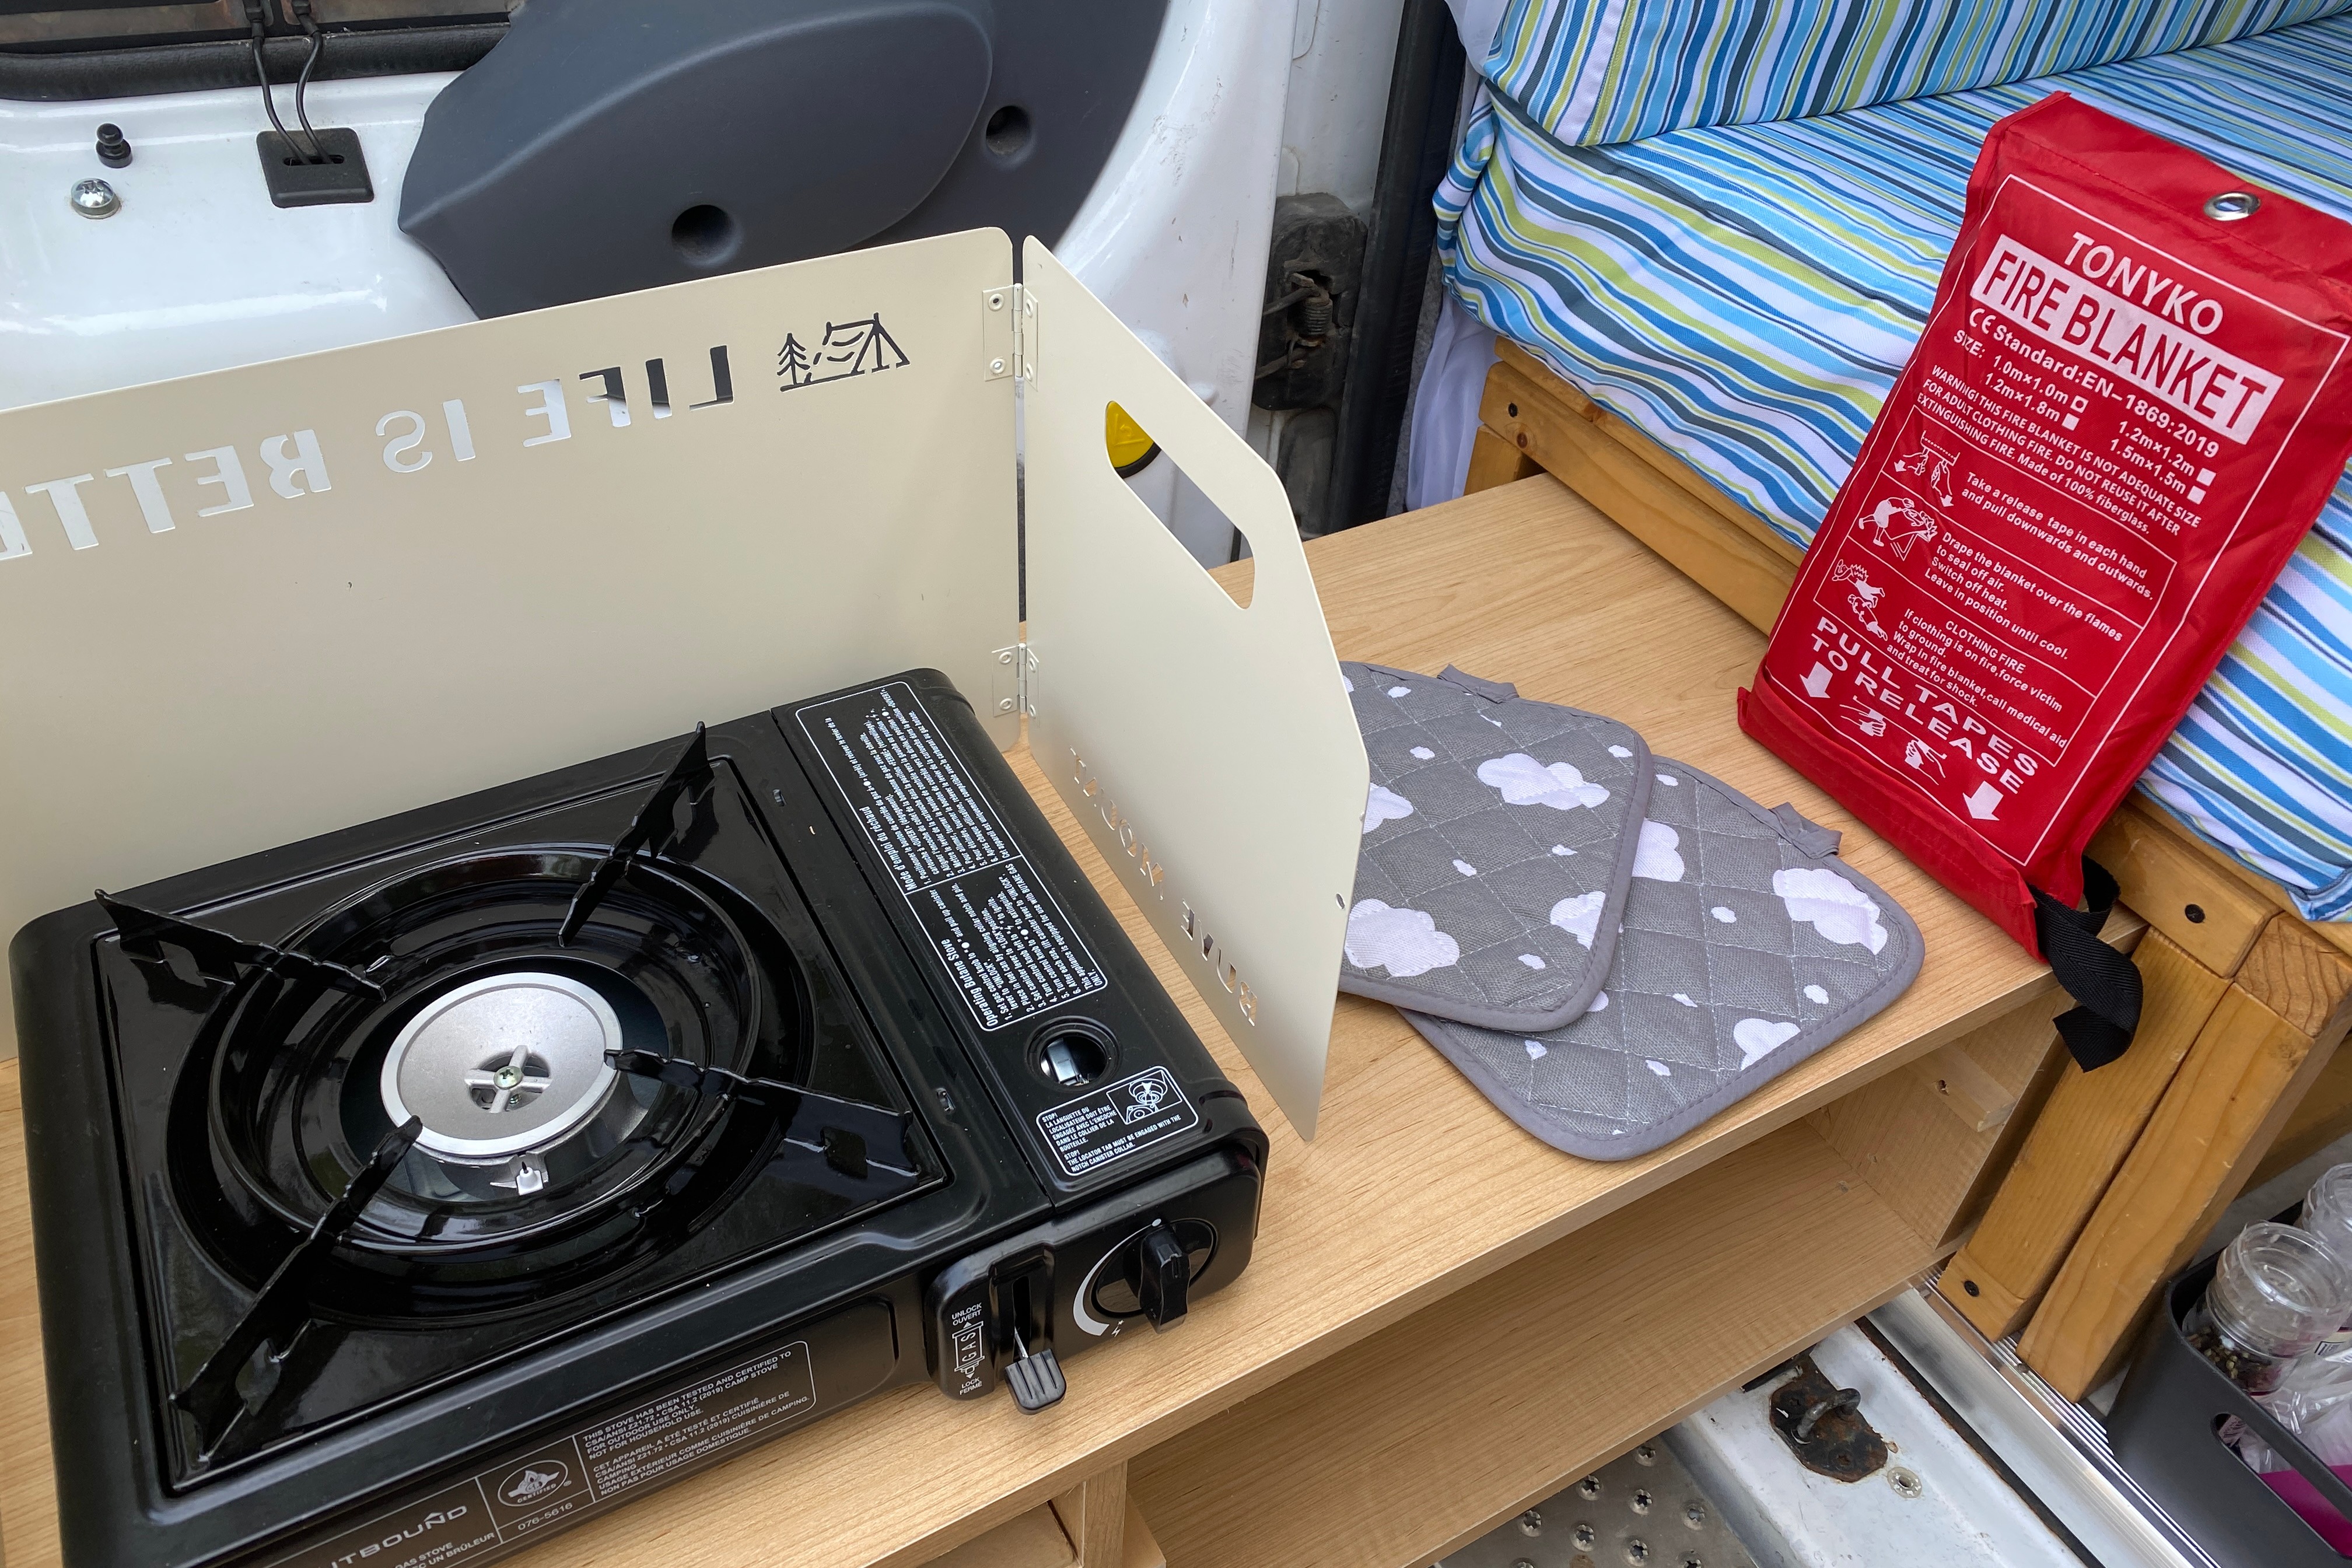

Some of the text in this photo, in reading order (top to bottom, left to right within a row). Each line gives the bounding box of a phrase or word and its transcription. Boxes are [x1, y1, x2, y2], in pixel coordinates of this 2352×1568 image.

[2064, 232, 2223, 334] TONYKO
[1983, 250, 2267, 429] FIRE BLANKET
[1917, 393, 2149, 534] EXTINGUISHING FIRE. Made of 100% fiberglass.
[1923, 379, 2180, 536] FOR ADULT CLOTHING FIRE. DO NOT REUSE IT AFTER
[1932, 365, 2202, 527] WARNING! THIS FIRE BLANKET IS NOT ADEQUATE SIZE
[1962, 489, 2152, 600] and pull downwards and outwards.
[1968, 472, 2147, 579] Take a release tape in each hand
[1932, 556, 2007, 611] Switch off heat.
[1937, 545, 2004, 592] to seal off air.
[1943, 532, 2123, 641] Drape the blanket over the flames
[1899, 621, 1946, 657] to ground.
[1924, 568, 2067, 659] Leave in position until cool.
[1905, 608, 1914, 619] If
[1913, 617, 1953, 647] clothing
[1953, 640, 1964, 652] is
[1965, 650, 1978, 662] on
[2031, 687, 2062, 712] victim
[1946, 621, 2026, 674] CLOTHING FIRE
[1817, 617, 2038, 776] PULL TAPES
[1887, 645, 1978, 707] and treat for shock.
[1894, 631, 1917, 653] Wrap
[1917, 648, 1928, 660] in
[1930, 656, 1947, 671] fire
[2007, 706, 2051, 736] medical
[2049, 733, 2067, 748] aid
[1811, 634, 2024, 794] TO RELEASE
[859, 806, 883, 832] réchaud
[877, 832, 888, 841] du
[900, 871, 918, 891] Mode
[941, 939, 998, 1027] Operating Butane Stove
[952, 1302, 982, 1320] UNLOCK
[953, 1308, 982, 1326] OUVERT
[960, 1332, 977, 1363] GAS
[583, 1430, 603, 1441] THIS
[605, 1416, 634, 1432] STOVE
[636, 1408, 654, 1419] HAS
[656, 1397, 680, 1411] BEEN
[681, 1383, 714, 1400] TESTED
[716, 1375, 733, 1387] AND
[736, 1357, 778, 1377] CERTIFIED
[585, 1363, 778, 1447] CSA/ANSI Z21.72 CSA 11.2 (2019) CAMP STOVE
[960, 1381, 982, 1395] FERMÉ
[962, 1377, 980, 1389] LOCK
[587, 1404, 697, 1454] FOR OUTDOOR USE ONLY.
[589, 1408, 704, 1460] NOT FOR HOUSEHOLD USE.
[517, 1483, 556, 1503] CERTIFIED
[597, 1464, 636, 1483] CAMPING
[518, 1503, 572, 1530] 076-5616
[418, 1542, 453, 1561] STOVE
